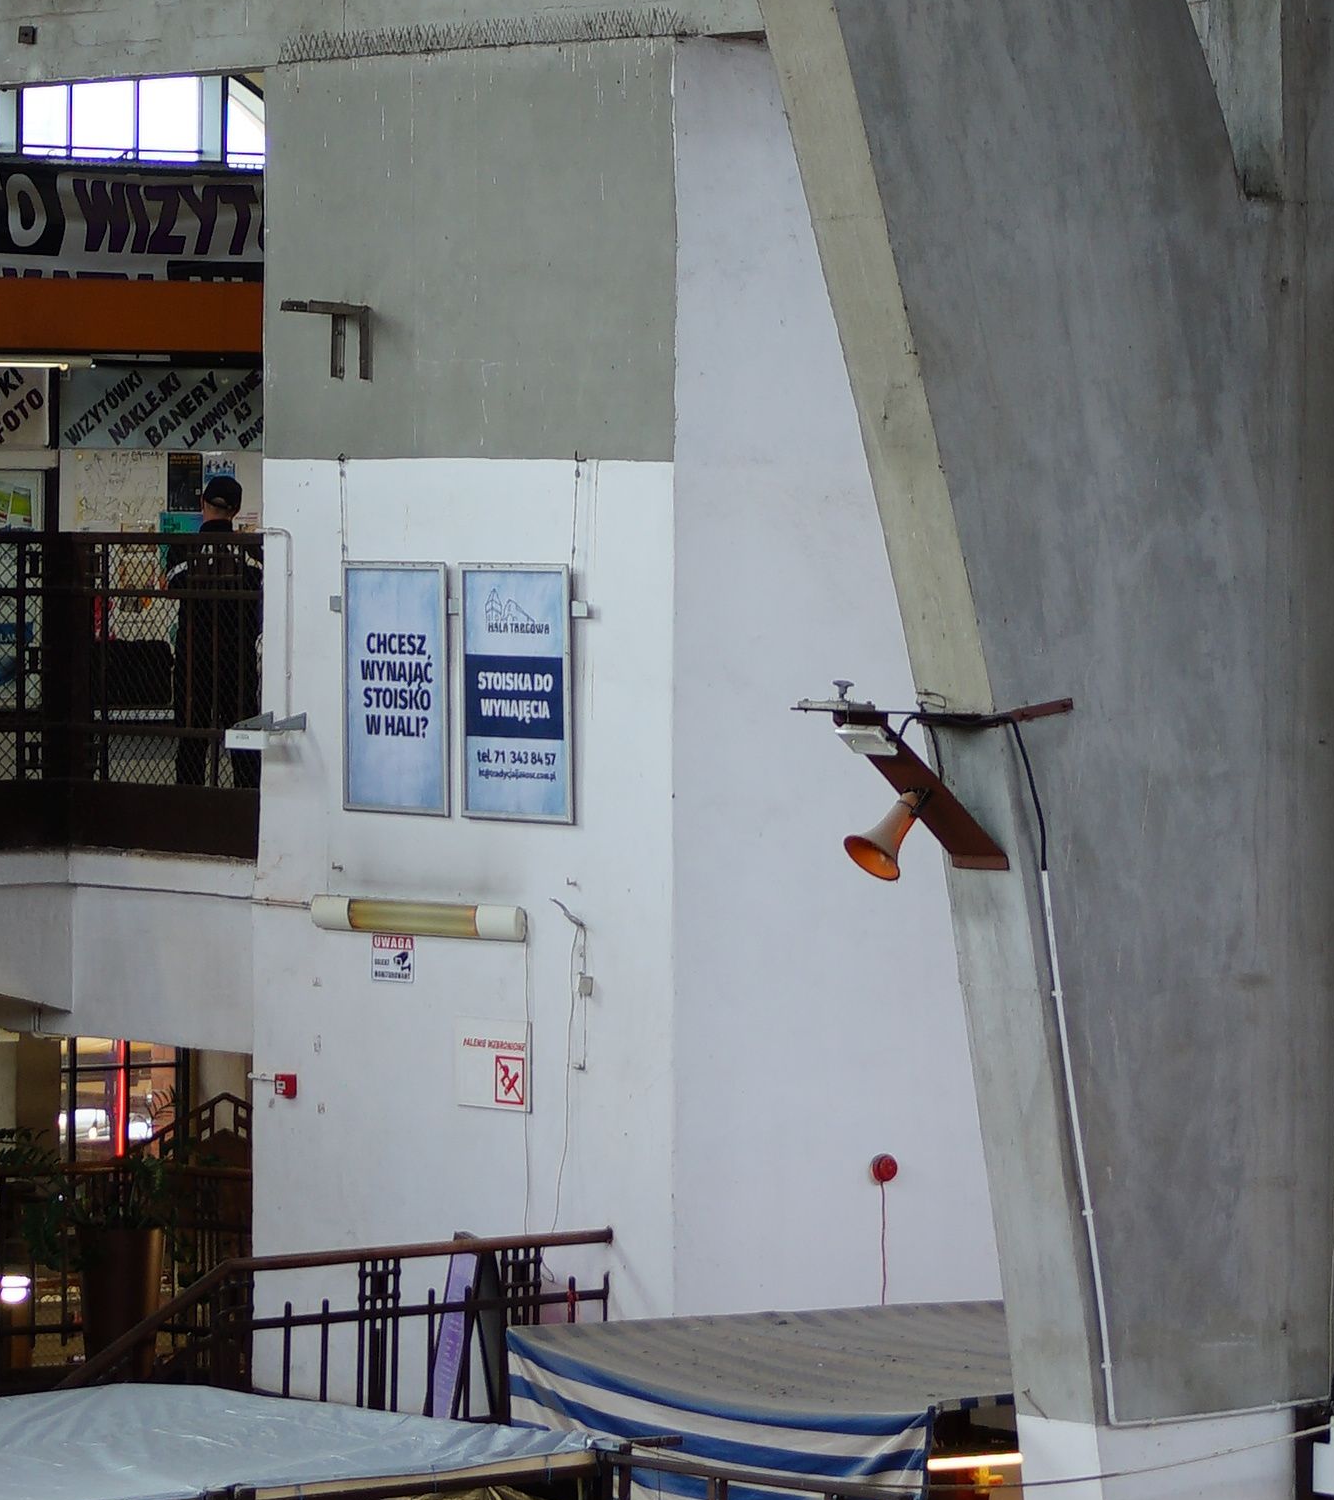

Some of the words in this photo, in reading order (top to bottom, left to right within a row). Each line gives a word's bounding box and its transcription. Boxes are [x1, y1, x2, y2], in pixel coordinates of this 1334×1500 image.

[73, 178, 264, 256] WIZYT
[64, 370, 144, 446] WIZYTÓWKI
[108, 371, 182, 446] NAKLEJKI
[144, 370, 218, 448] BANERY
[366, 632, 427, 657] CHCESZ
[360, 652, 433, 690] WYNAJĄĆ
[477, 671, 532, 691] STOISKA
[534, 673, 554, 693] DO
[363, 686, 431, 711] STOISKO
[480, 698, 551, 723] WYNAJĘCIA
[366, 713, 382, 735] W
[385, 715, 429, 739] HALI?
[494, 750, 506, 764] 71
[510, 751, 529, 765] 343
[531, 752, 544, 765] 84
[545, 753, 557, 766] 57
[373, 936, 413, 950] UWAGA
